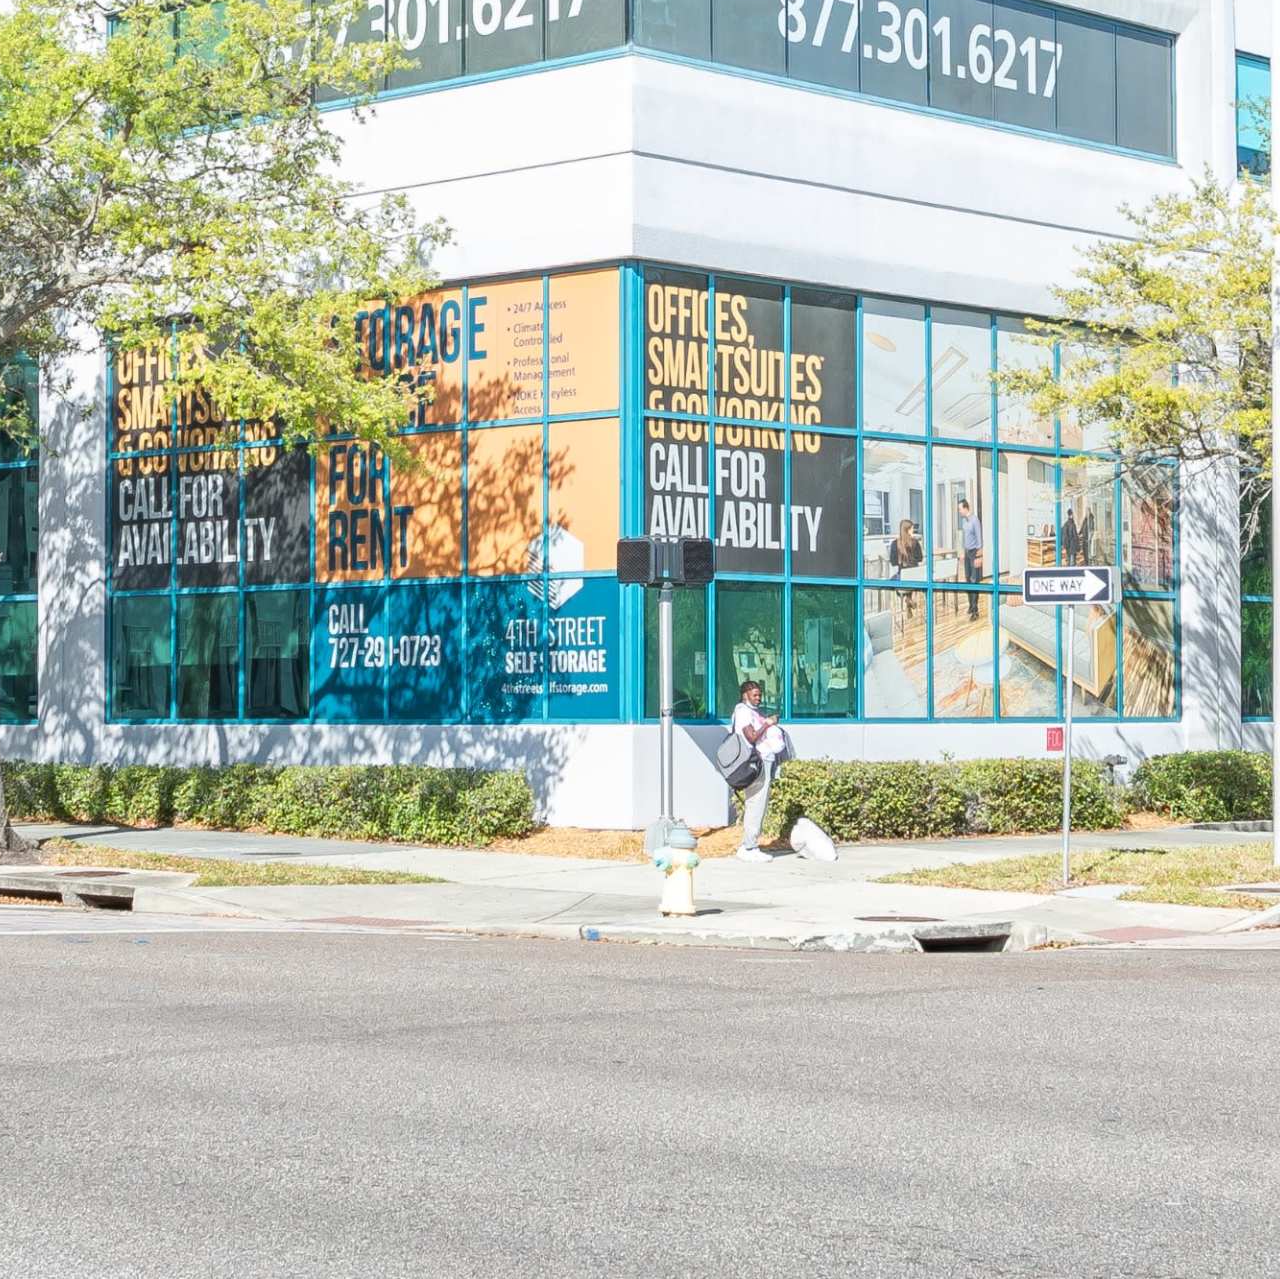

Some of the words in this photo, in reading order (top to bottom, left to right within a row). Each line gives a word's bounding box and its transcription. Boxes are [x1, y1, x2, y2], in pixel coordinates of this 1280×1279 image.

[513, 303, 532, 314] 24/7
[331, 296, 488, 372] TORAGE
[513, 332, 563, 347] Controled
[513, 352, 570, 367] Professonal
[671, 391, 822, 454] COWORKING
[329, 441, 387, 505] FOR
[649, 442, 709, 494] CALL
[715, 449, 767, 499] FOR
[120, 476, 173, 521] CALL
[179, 474, 224, 519] FOR
[118, 517, 276, 567] AVAIABILITY
[329, 506, 414, 571] RENT
[1033, 579, 1056, 593] ONE
[1060, 579, 1084, 592] WAY
[328, 603, 369, 635] CALL
[505, 618, 538, 649] 4TH
[548, 616, 607, 647] STREET
[328, 635, 442, 669] 727-291-0723
[505, 651, 537, 674] SELF
[501, 681, 608, 696] 4thstreetslfstorage.com
